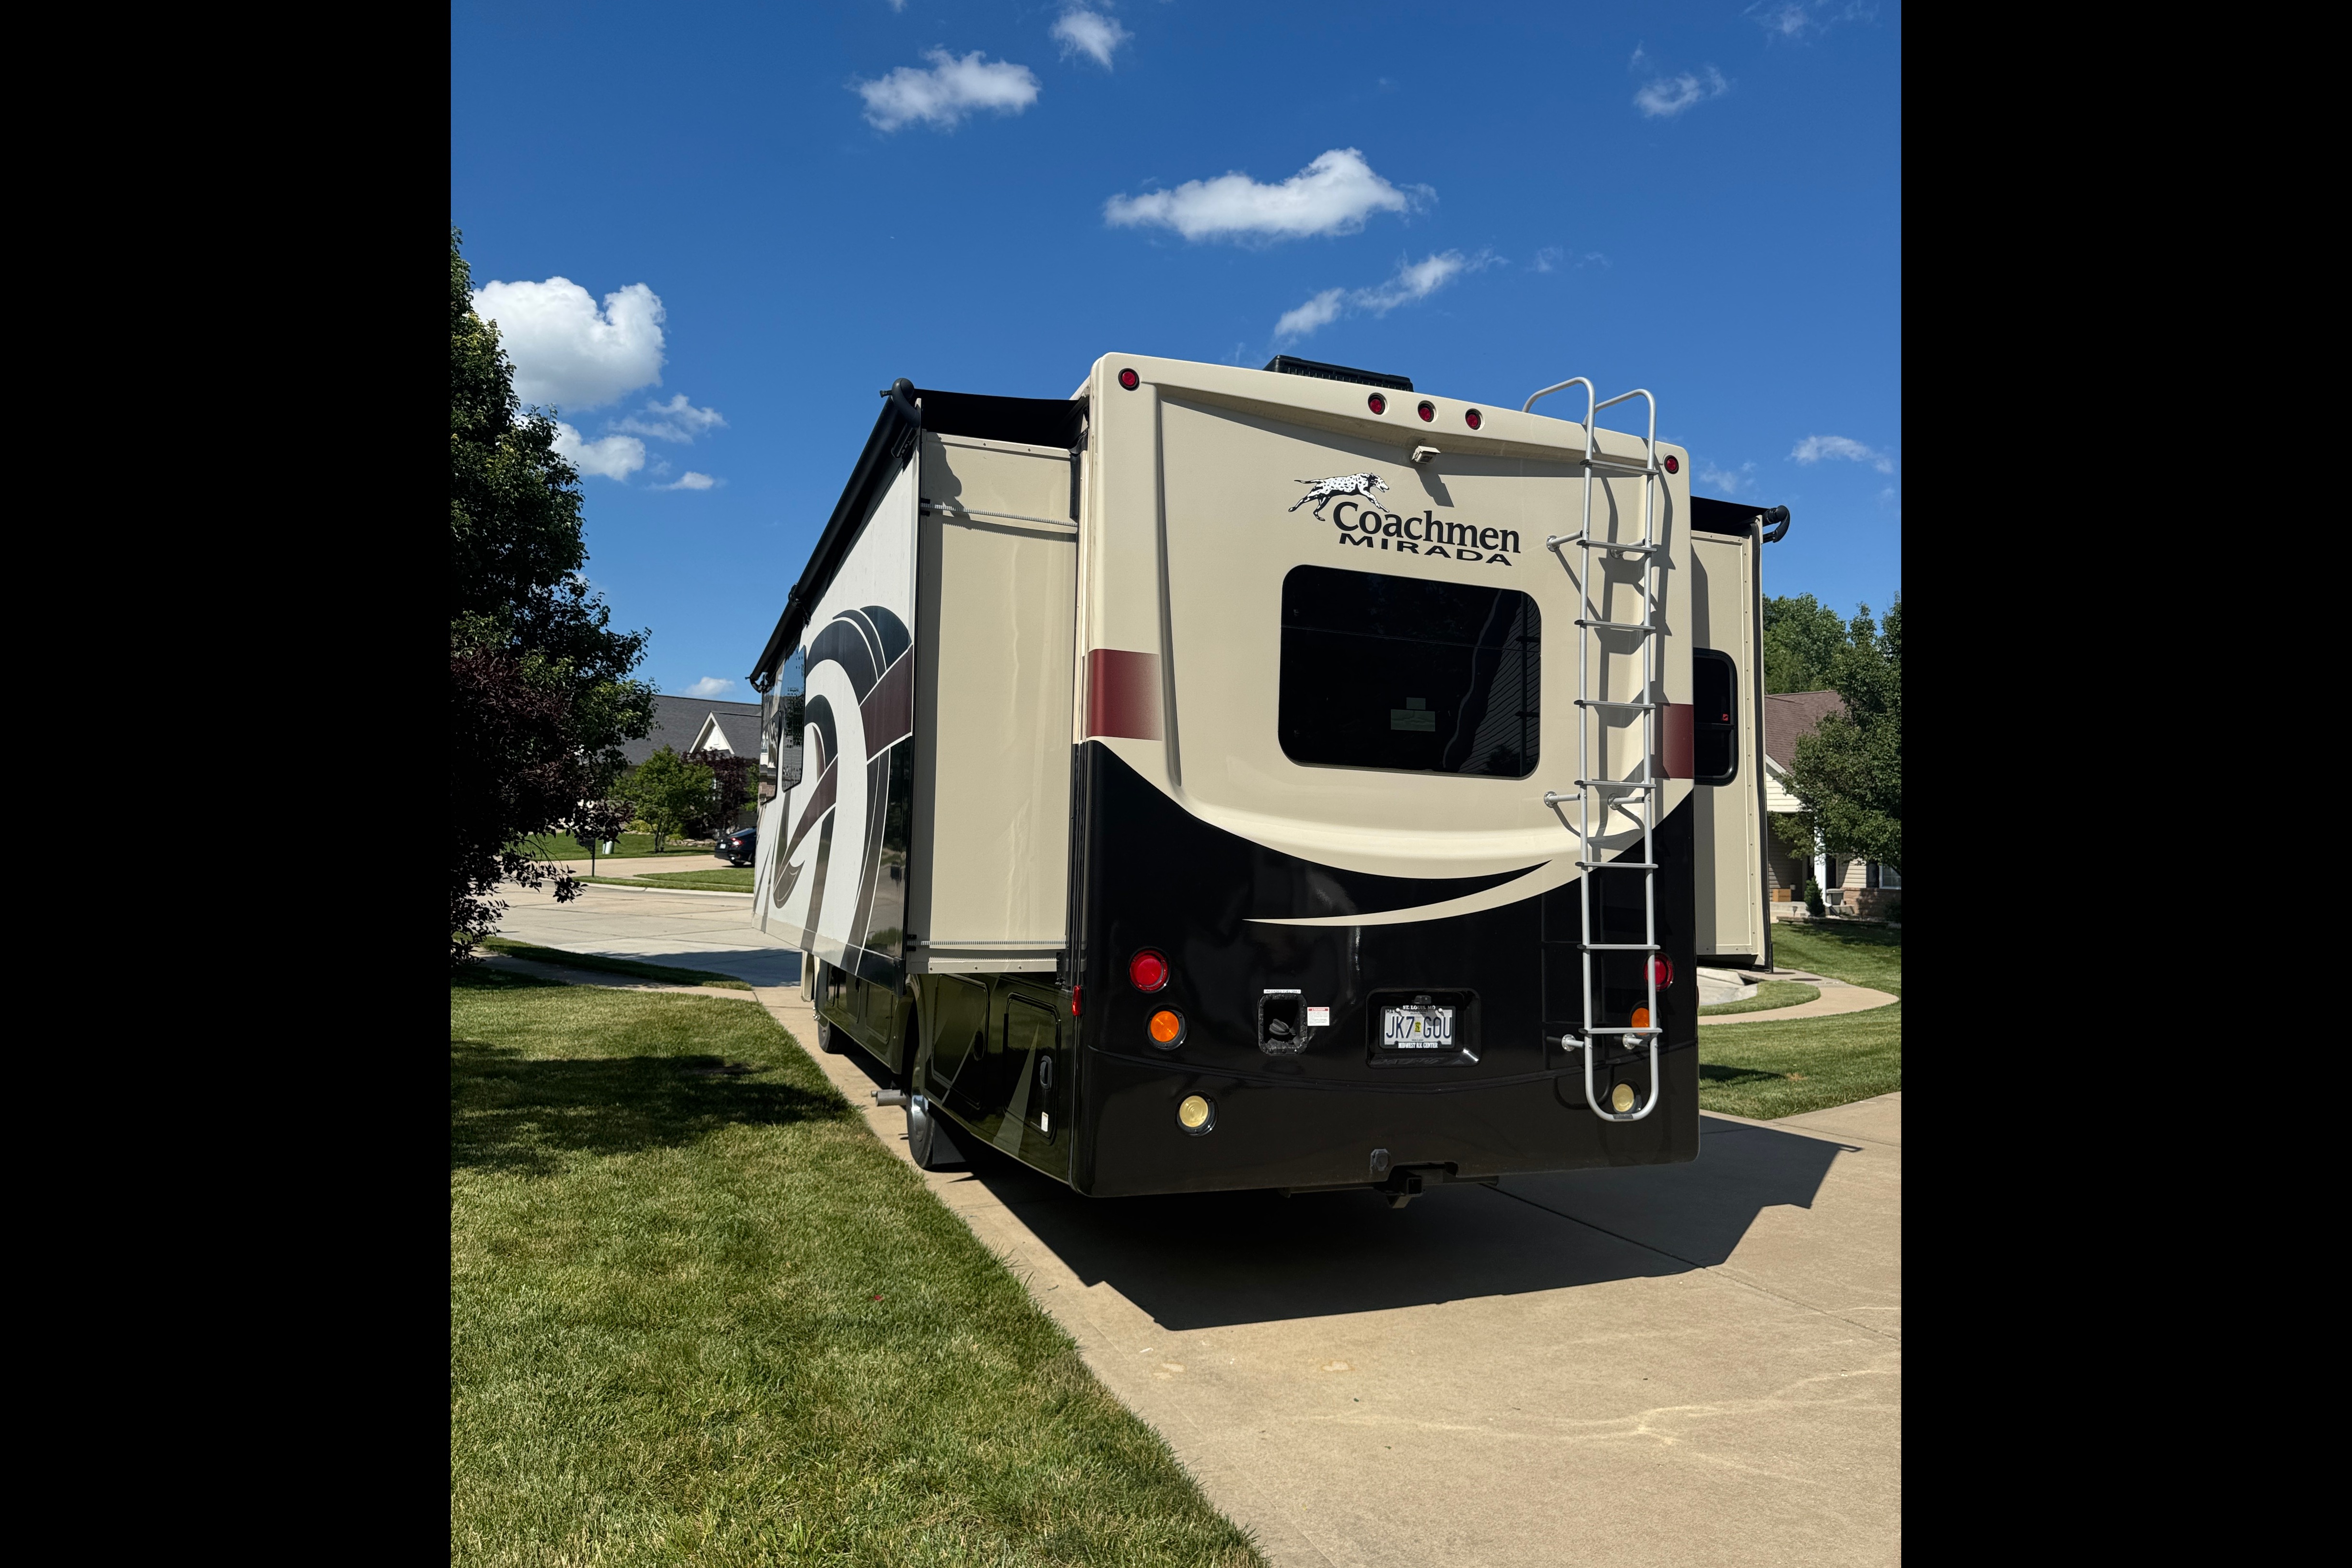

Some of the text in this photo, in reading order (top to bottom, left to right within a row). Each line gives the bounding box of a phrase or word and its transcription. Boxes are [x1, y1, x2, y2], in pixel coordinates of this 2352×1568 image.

[1333, 501, 1521, 554] Coachmen
[1339, 533, 1513, 566] MIRADA
[1386, 1016, 1415, 1038] JK7
